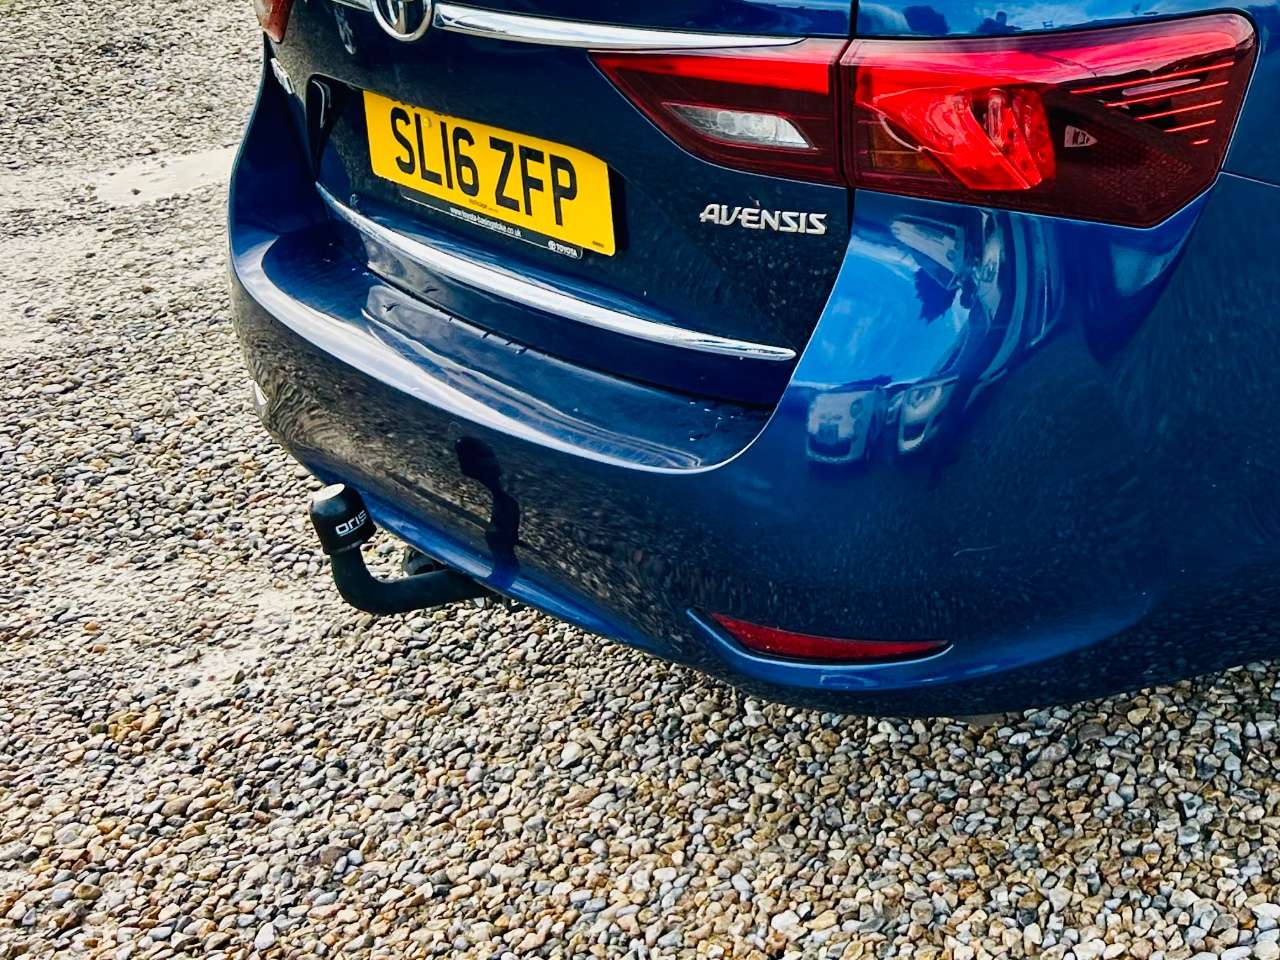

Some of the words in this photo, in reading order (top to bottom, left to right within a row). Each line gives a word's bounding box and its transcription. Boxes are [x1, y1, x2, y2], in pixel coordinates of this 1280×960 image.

[390, 106, 480, 197] SL16
[489, 136, 578, 226] ZFP
[699, 203, 828, 235] AVENSIS
[554, 242, 579, 258] TOYOTA
